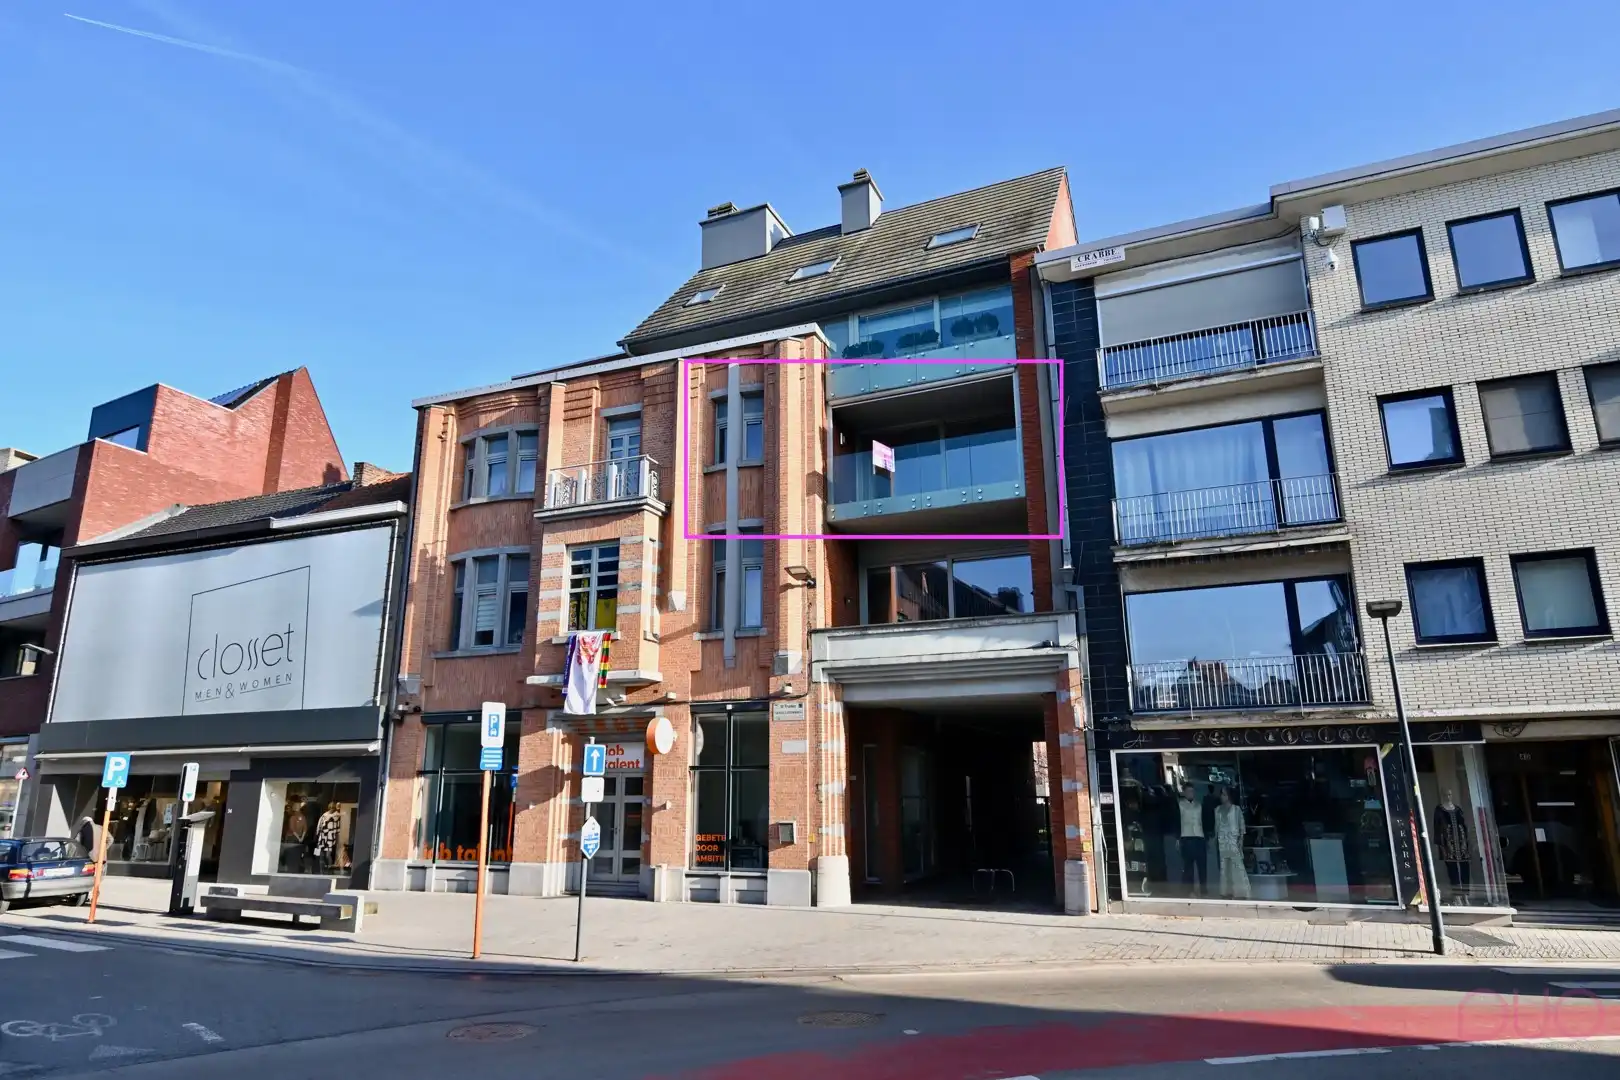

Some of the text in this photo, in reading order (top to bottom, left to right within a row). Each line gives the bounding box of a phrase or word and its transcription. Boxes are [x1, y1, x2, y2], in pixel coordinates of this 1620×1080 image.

[197, 623, 294, 680] closset
[194, 673, 293, 700] MEN & WOMEN
[490, 715, 499, 729] P
[106, 756, 127, 781] P
[456, 842, 513, 861] talnt
